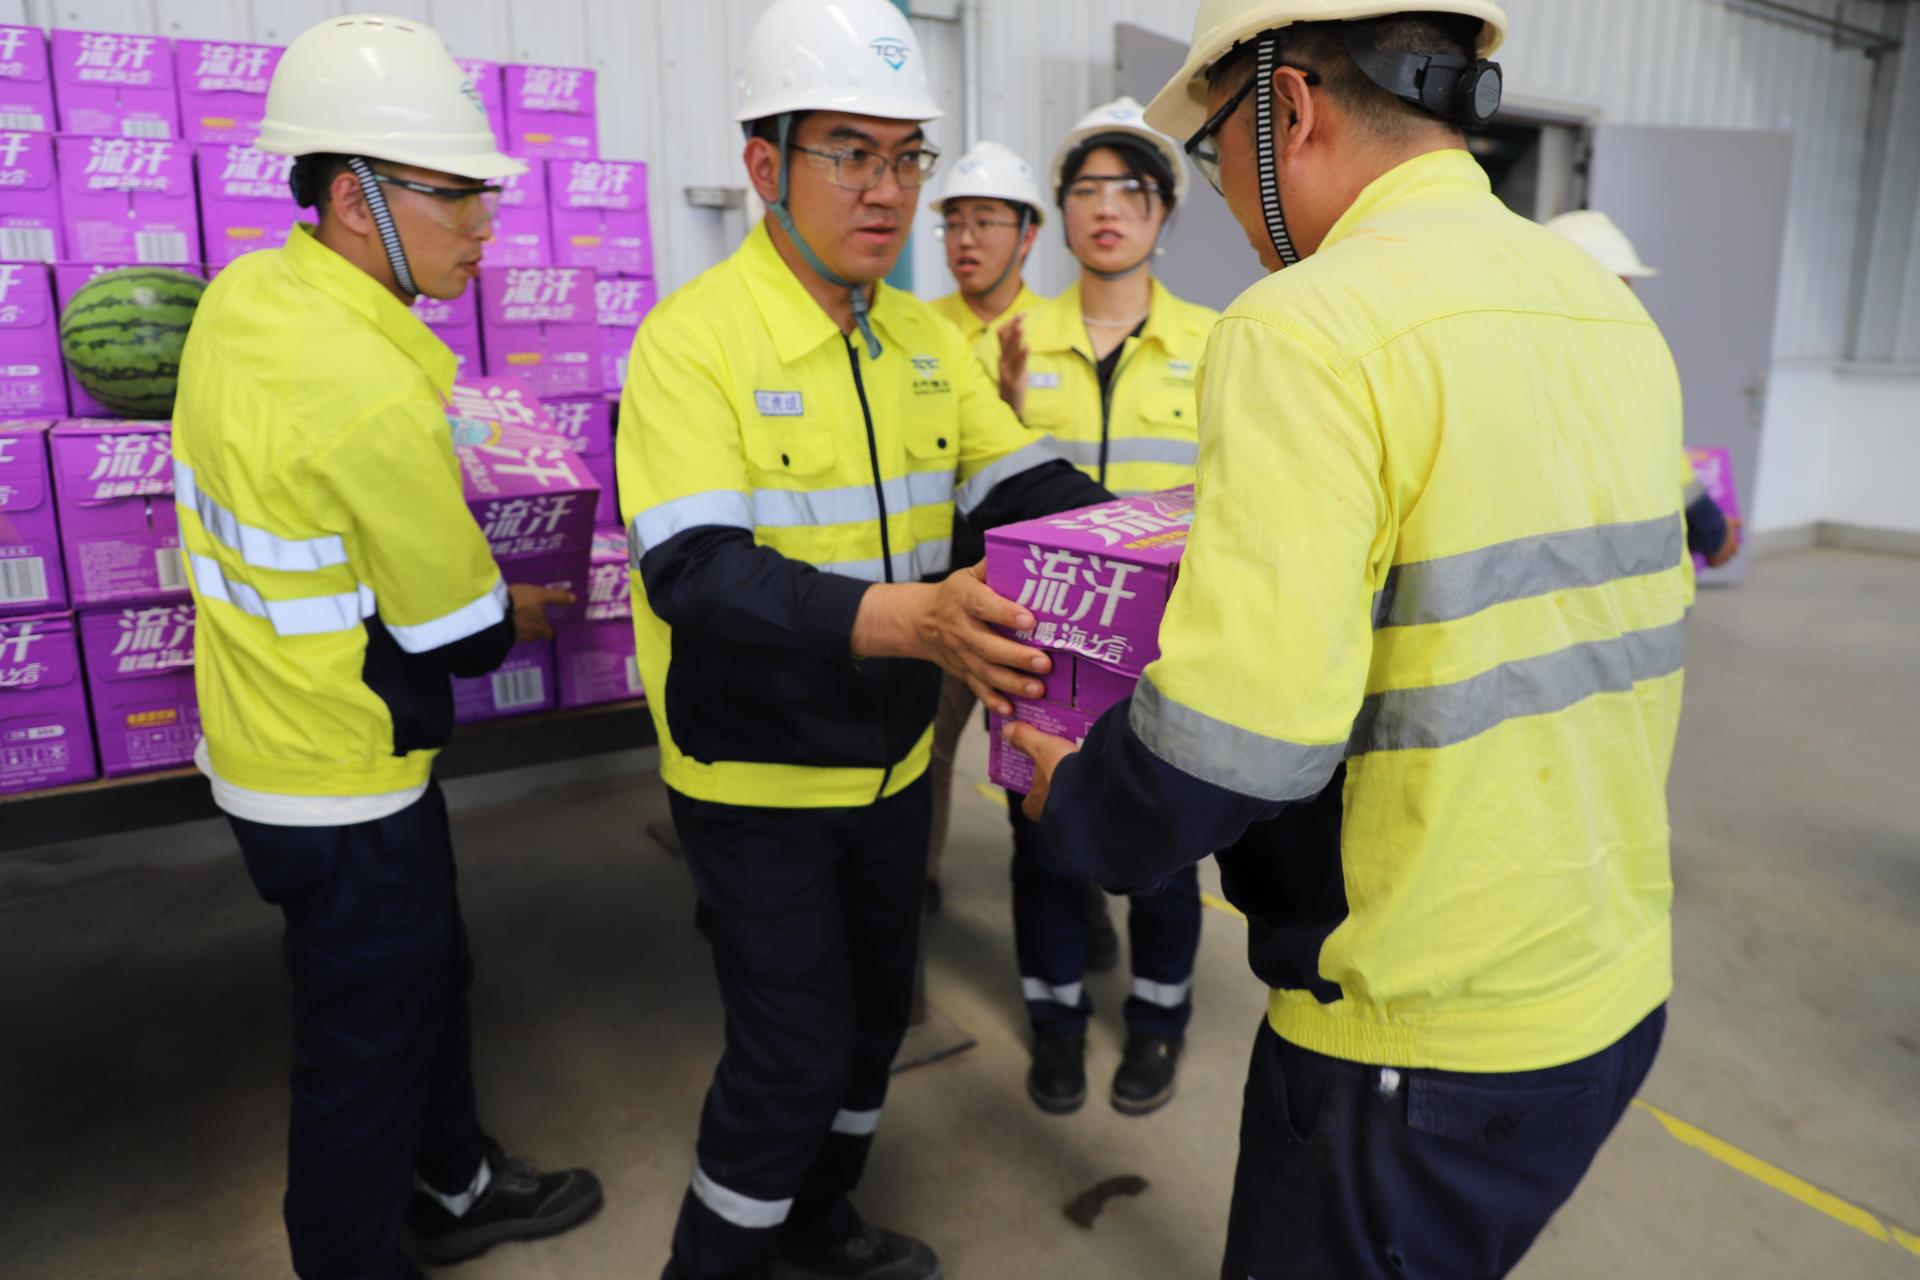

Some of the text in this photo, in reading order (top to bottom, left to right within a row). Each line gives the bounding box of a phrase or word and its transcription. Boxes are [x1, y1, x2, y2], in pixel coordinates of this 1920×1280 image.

[74, 33, 156, 70] 流汗
[194, 43, 271, 78] 流汗
[83, 137, 174, 175] 流汗
[566, 160, 634, 194] 流汗
[501, 268, 580, 304] 流汗
[483, 496, 577, 540] 流汗
[1016, 544, 1143, 627] 流汗
